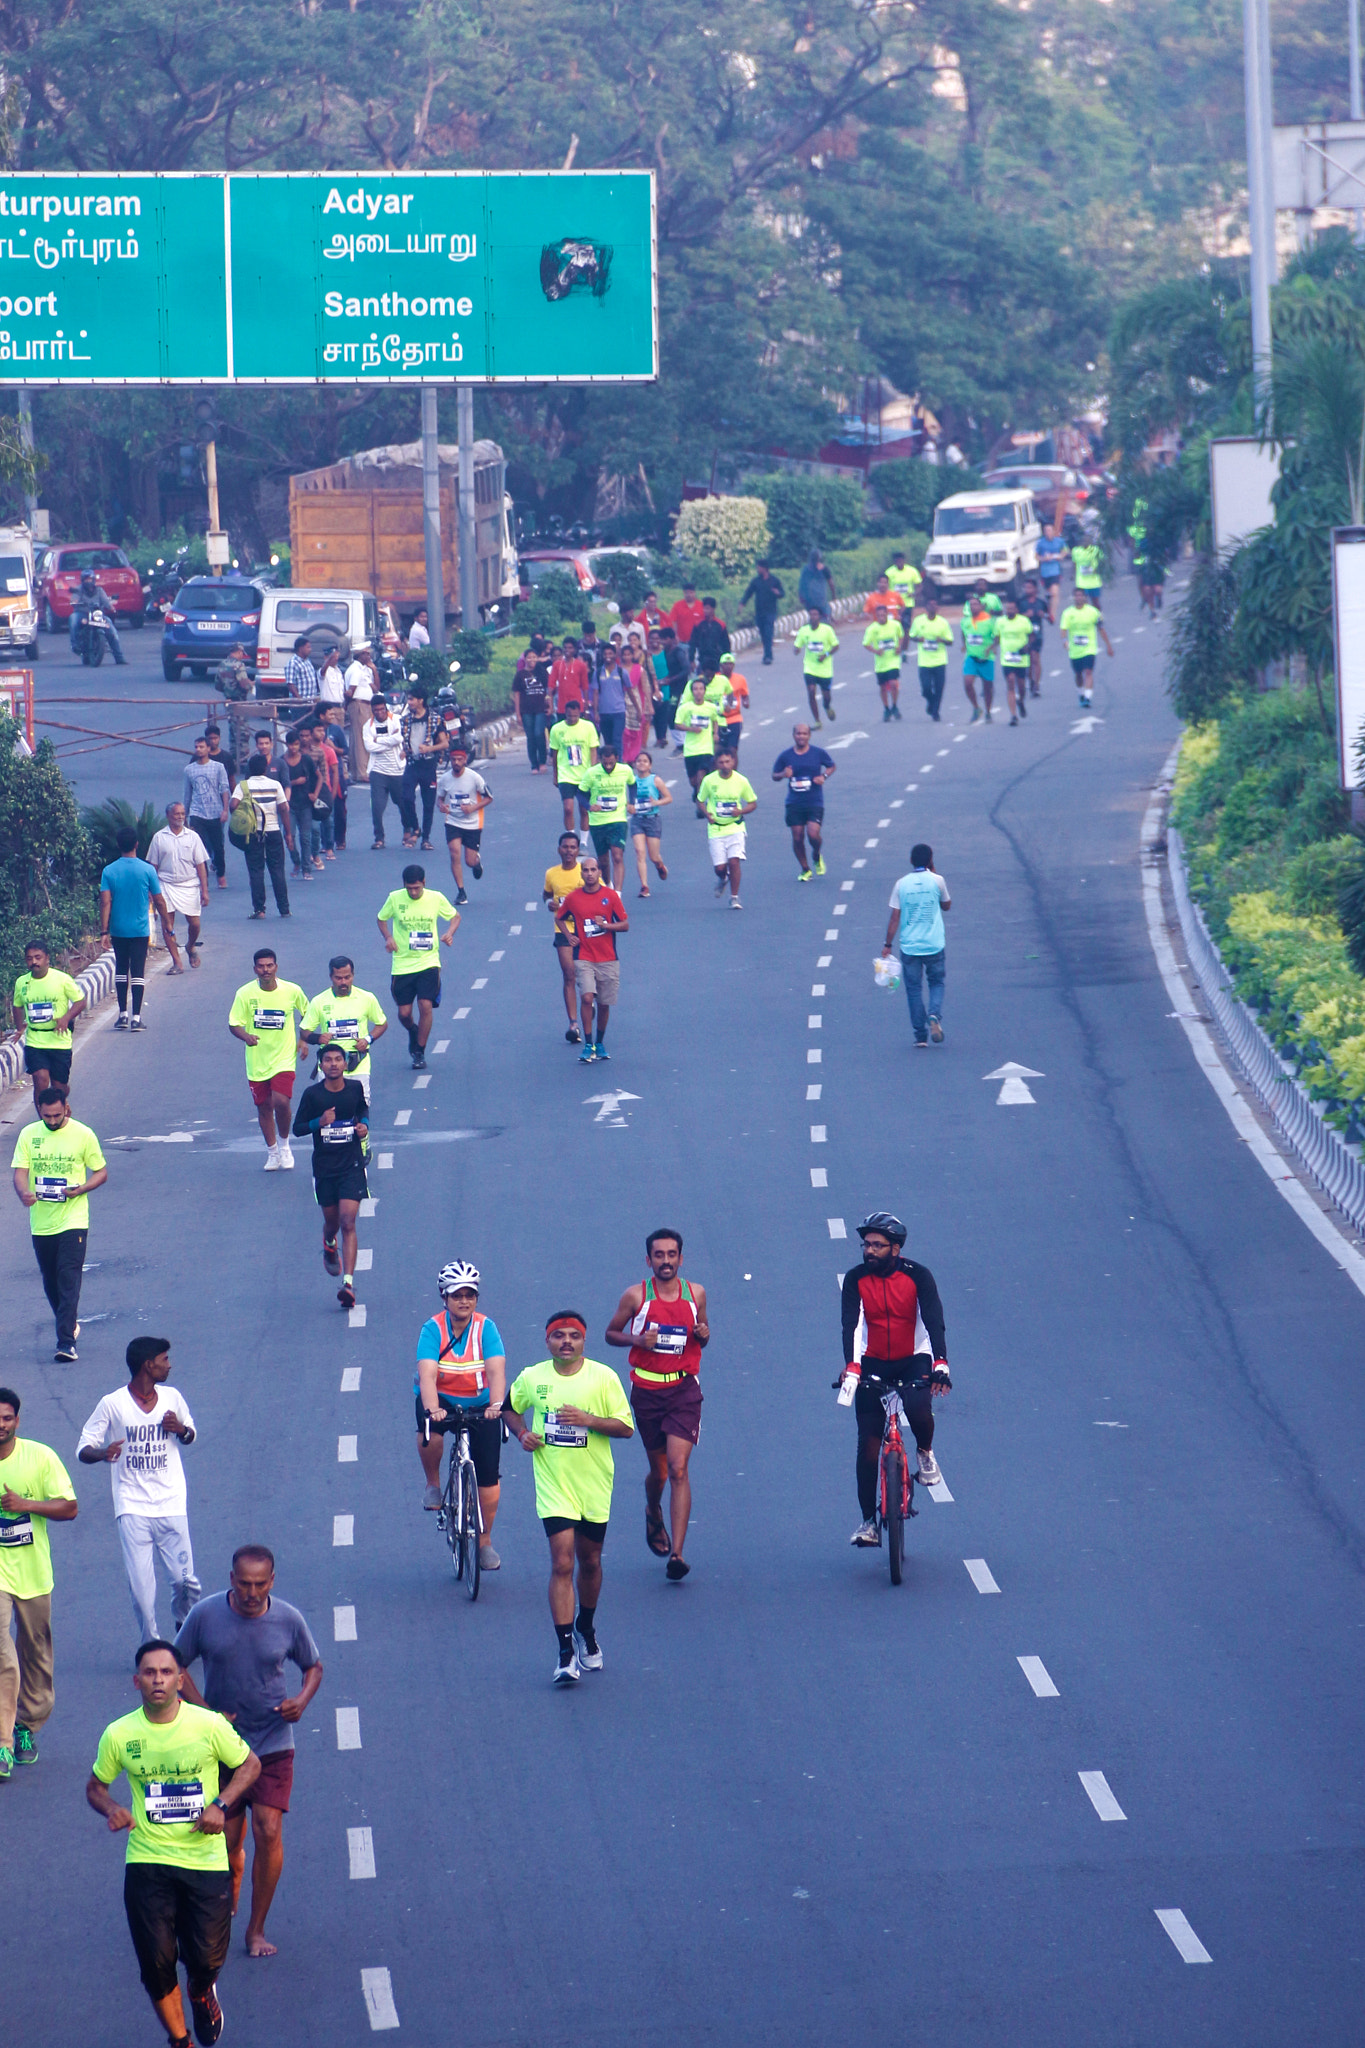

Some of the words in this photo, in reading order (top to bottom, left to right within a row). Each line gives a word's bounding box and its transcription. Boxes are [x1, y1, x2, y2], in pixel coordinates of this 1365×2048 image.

[323, 188, 414, 221] Adyar
[323, 234, 477, 262] அடையாறு
[324, 291, 473, 317] Santhome
[323, 333, 463, 371] சாந்தோம்
[126, 1454, 168, 1469] FORTUNE
[145, 1442, 151, 1455] A
